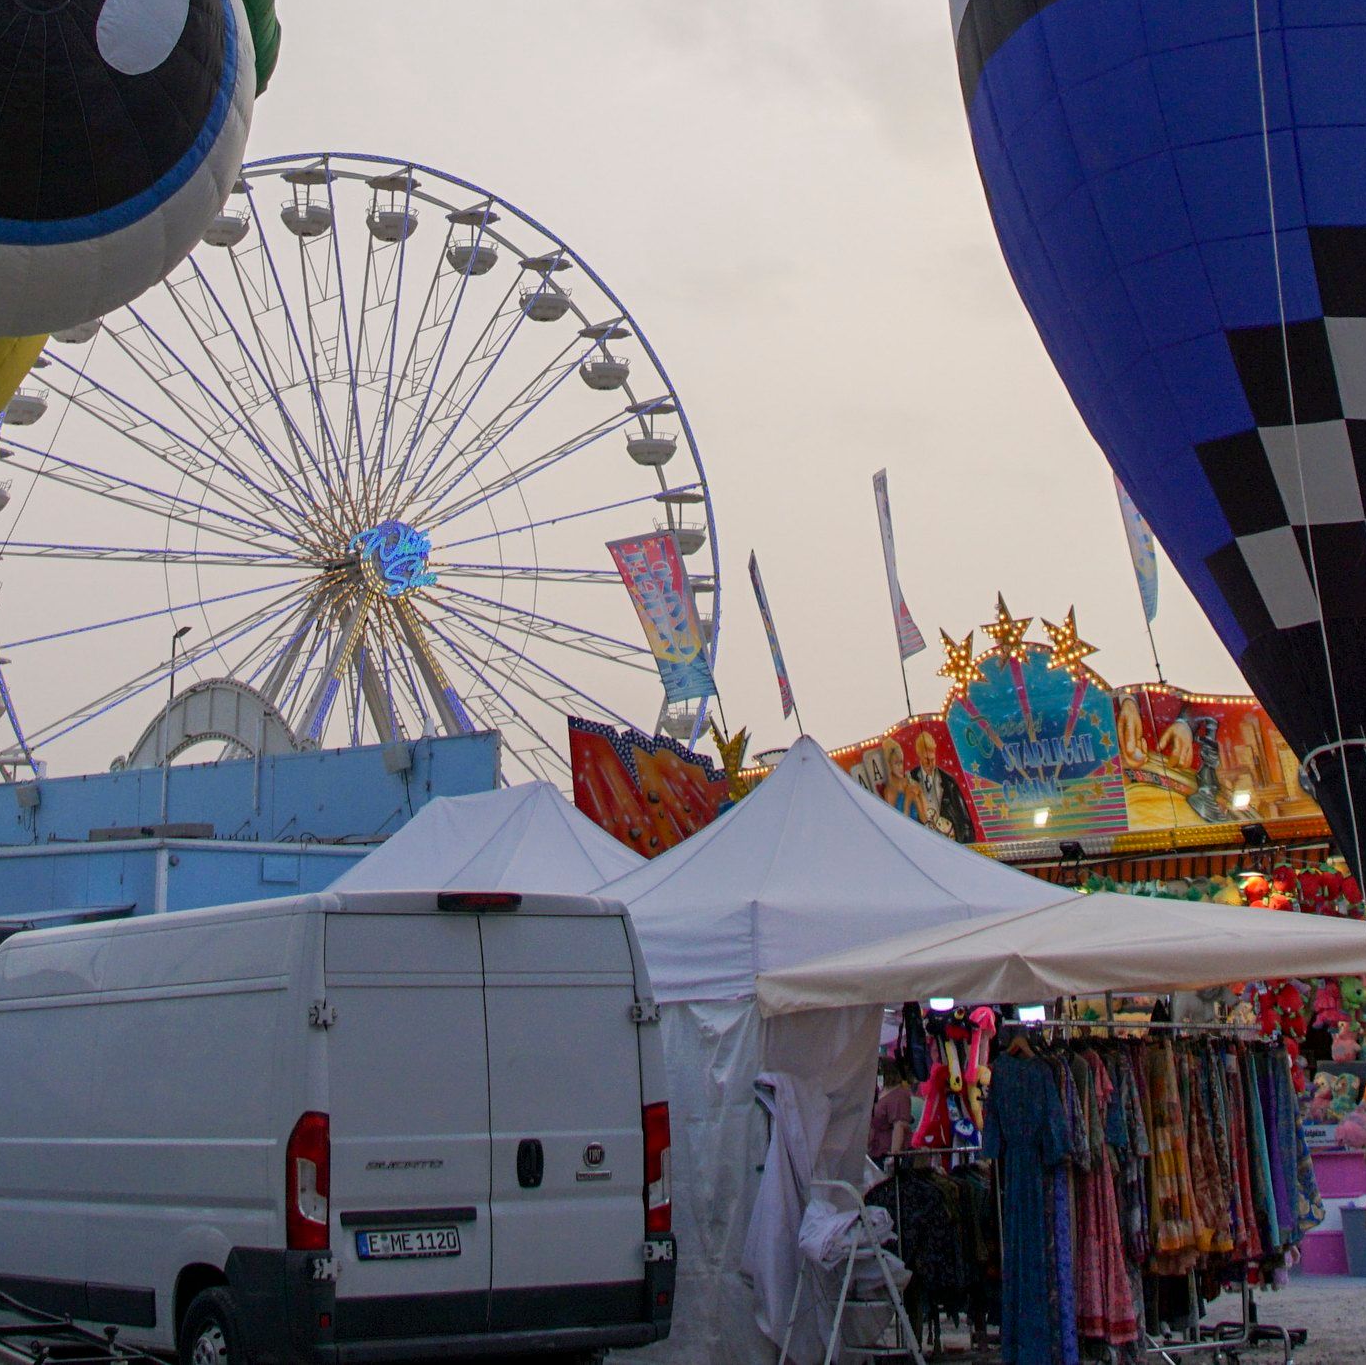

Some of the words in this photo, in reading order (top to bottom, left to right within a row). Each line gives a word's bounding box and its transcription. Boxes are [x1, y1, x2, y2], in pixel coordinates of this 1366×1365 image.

[1001, 734, 1096, 772] STARLIGHT
[369, 1234, 380, 1252] E
[390, 1233, 413, 1251] ME
[417, 1231, 457, 1250] 1120
